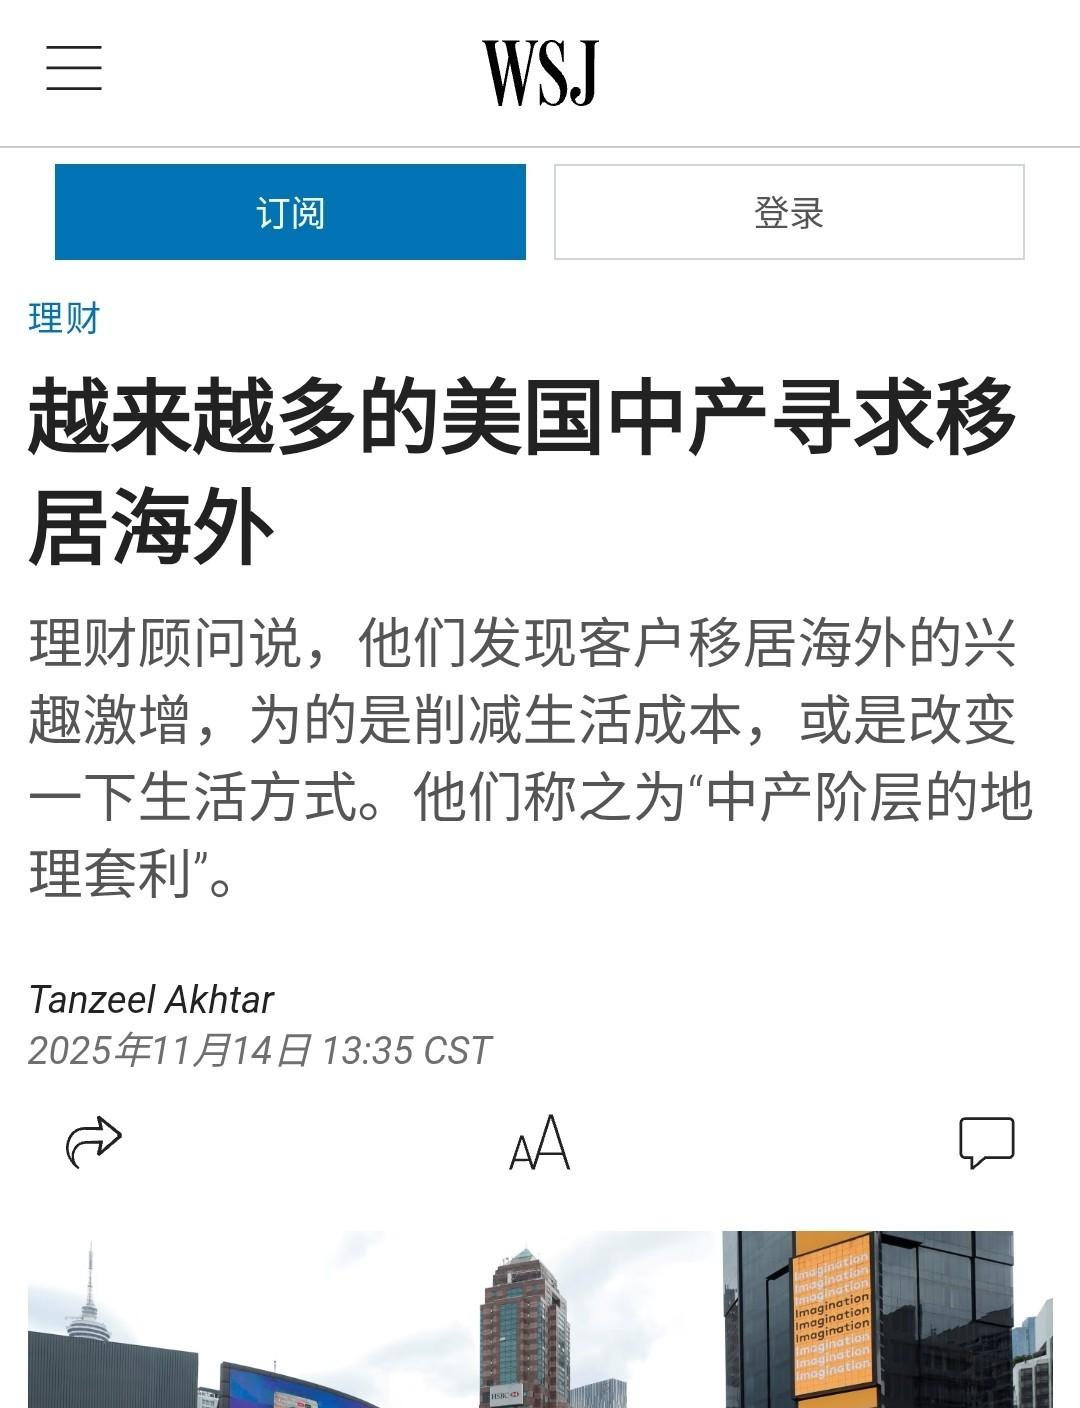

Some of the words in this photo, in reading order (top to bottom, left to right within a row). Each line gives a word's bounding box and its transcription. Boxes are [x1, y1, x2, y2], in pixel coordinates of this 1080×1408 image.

[482, 40, 599, 106] WSJ
[256, 196, 324, 229] 订阅
[755, 196, 823, 229] 登录
[29, 301, 100, 334] 理财
[28, 376, 1016, 456] 越来越多的美国中产寻求移
[29, 486, 274, 566] 居海外
[30, 616, 1015, 669] 理财顾问说，他们发现客户移居海外的兴
[29, 693, 1015, 746] 趣激增，为的是削减生活成本，或是改变
[31, 984, 156, 1013] Tanzeel
[164, 984, 275, 1013] Akhtar
[28, 1032, 312, 1067] 2025年11月14日
[325, 1036, 414, 1064] 13:35
[425, 1036, 494, 1064] CST
[794, 1254, 869, 1281] Imagination
[794, 1267, 869, 1294] Imagination
[795, 1279, 869, 1306] Imagination
[795, 1293, 869, 1318] Imagination
[796, 1306, 870, 1331] Imagination
[796, 1319, 870, 1343] Imagination
[796, 1333, 870, 1356] Imagination
[796, 1347, 871, 1369] Imagination
[796, 1359, 872, 1381] Imagination
[491, 1392, 510, 1400] HSBC
